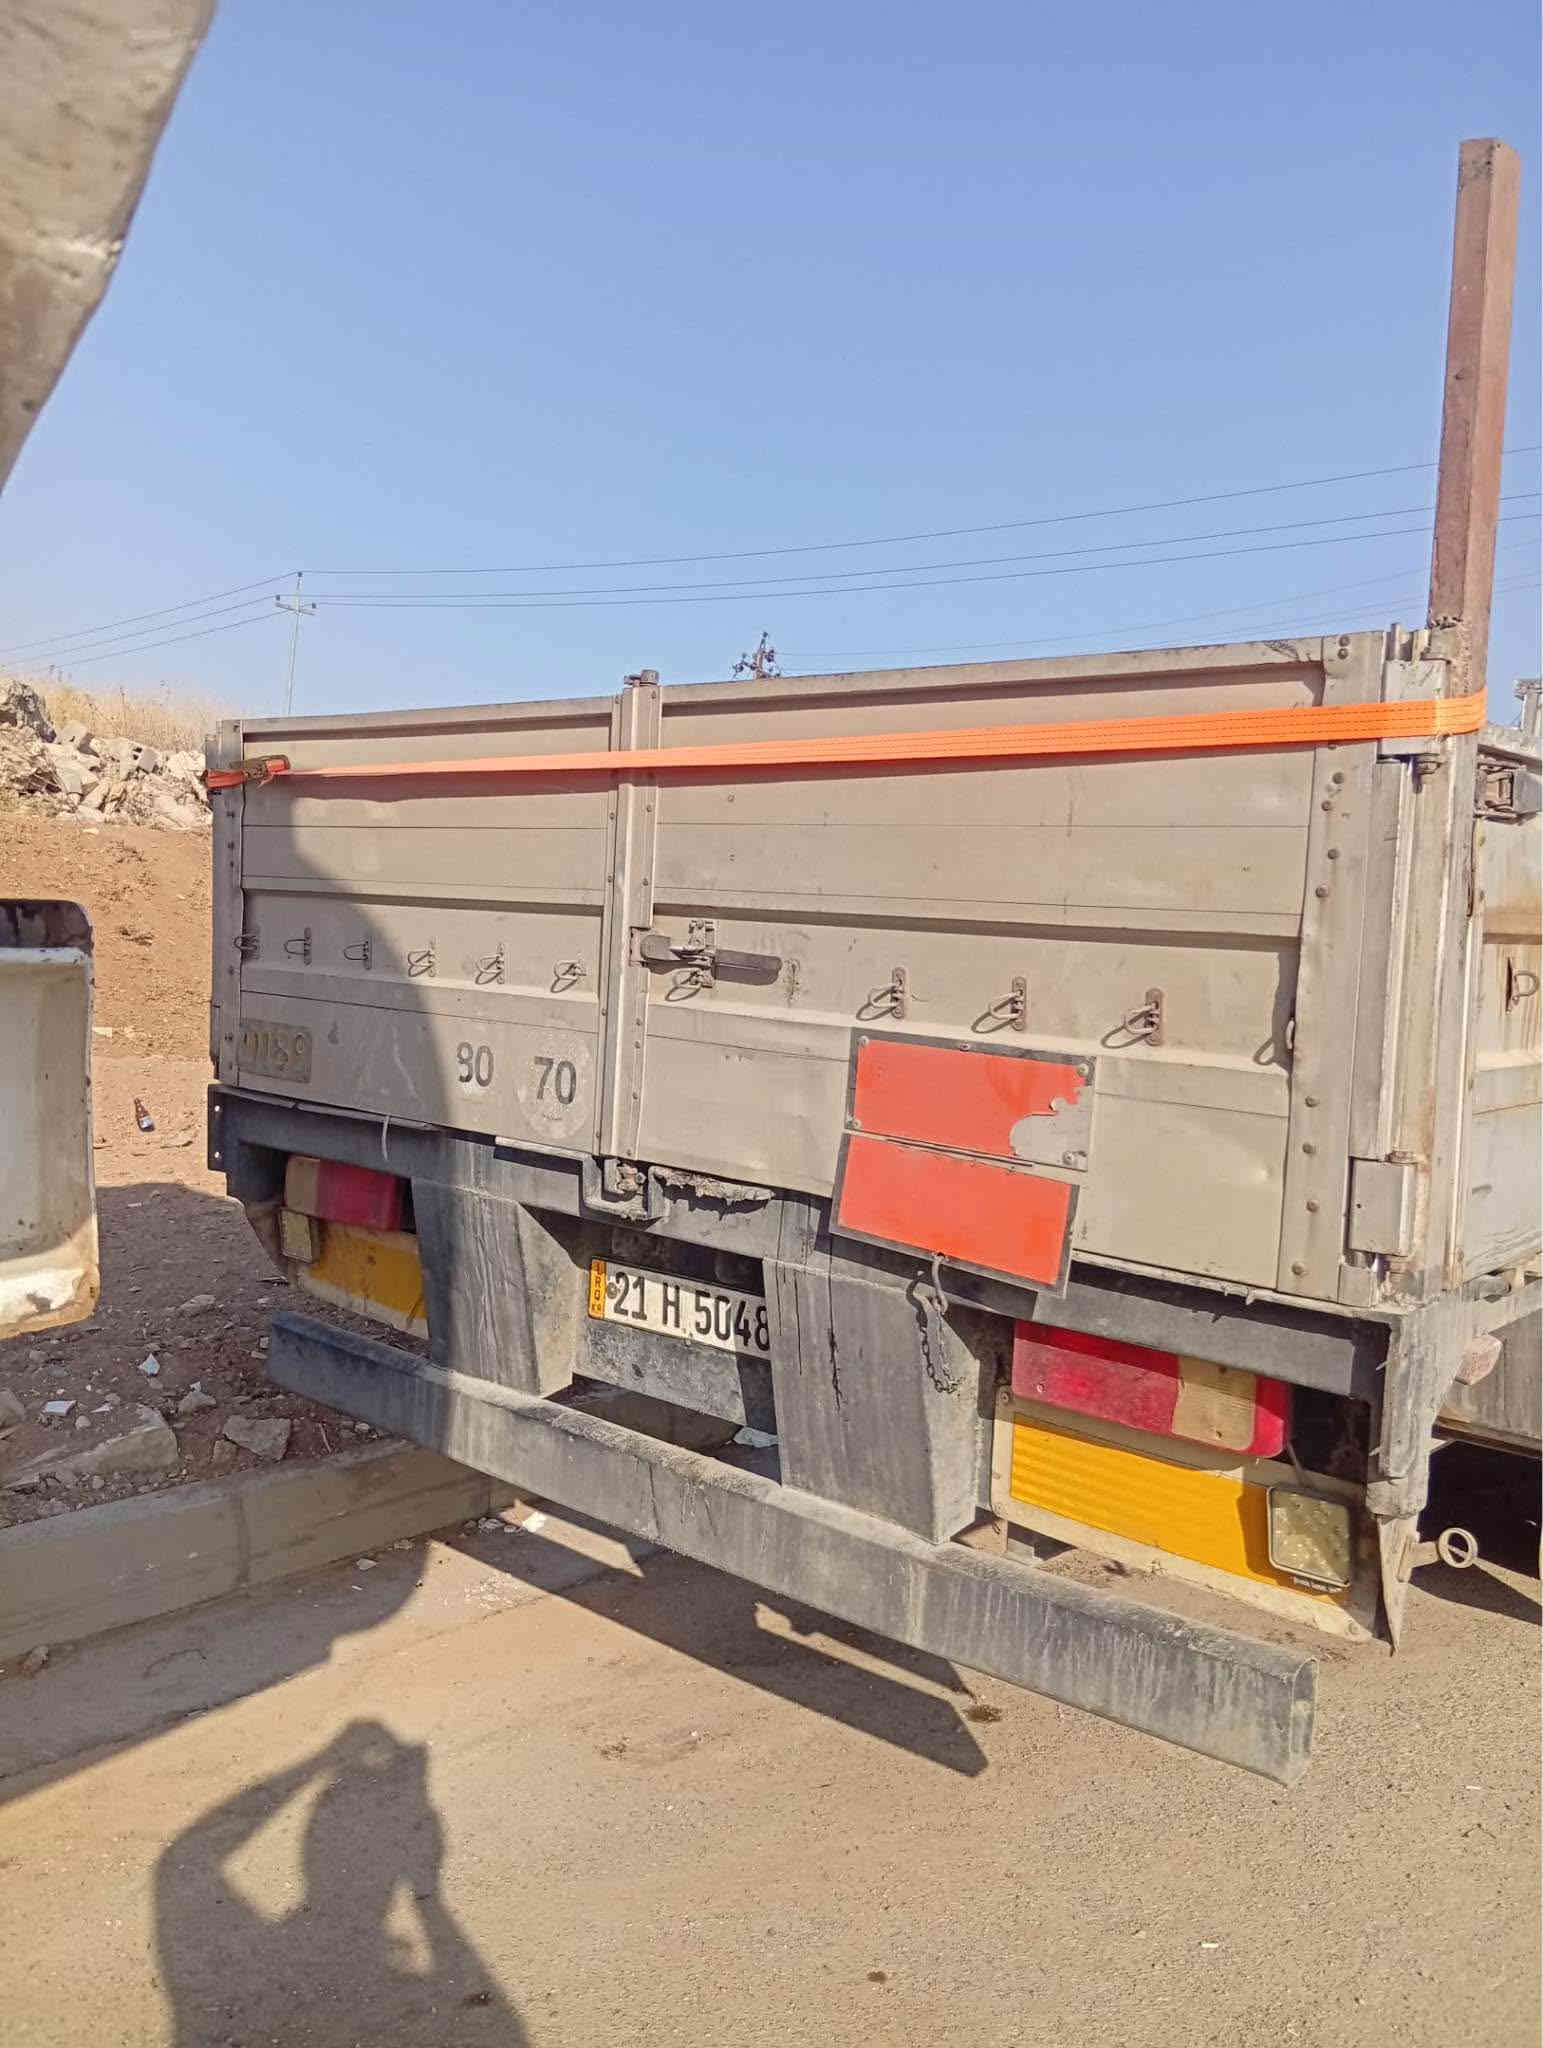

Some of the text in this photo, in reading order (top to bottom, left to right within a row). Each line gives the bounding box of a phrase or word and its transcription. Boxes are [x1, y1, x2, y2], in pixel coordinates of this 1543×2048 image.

[456, 1041, 494, 1087] 90
[534, 1055, 577, 1105] 70
[614, 1271, 770, 1351] 21 H 5048
